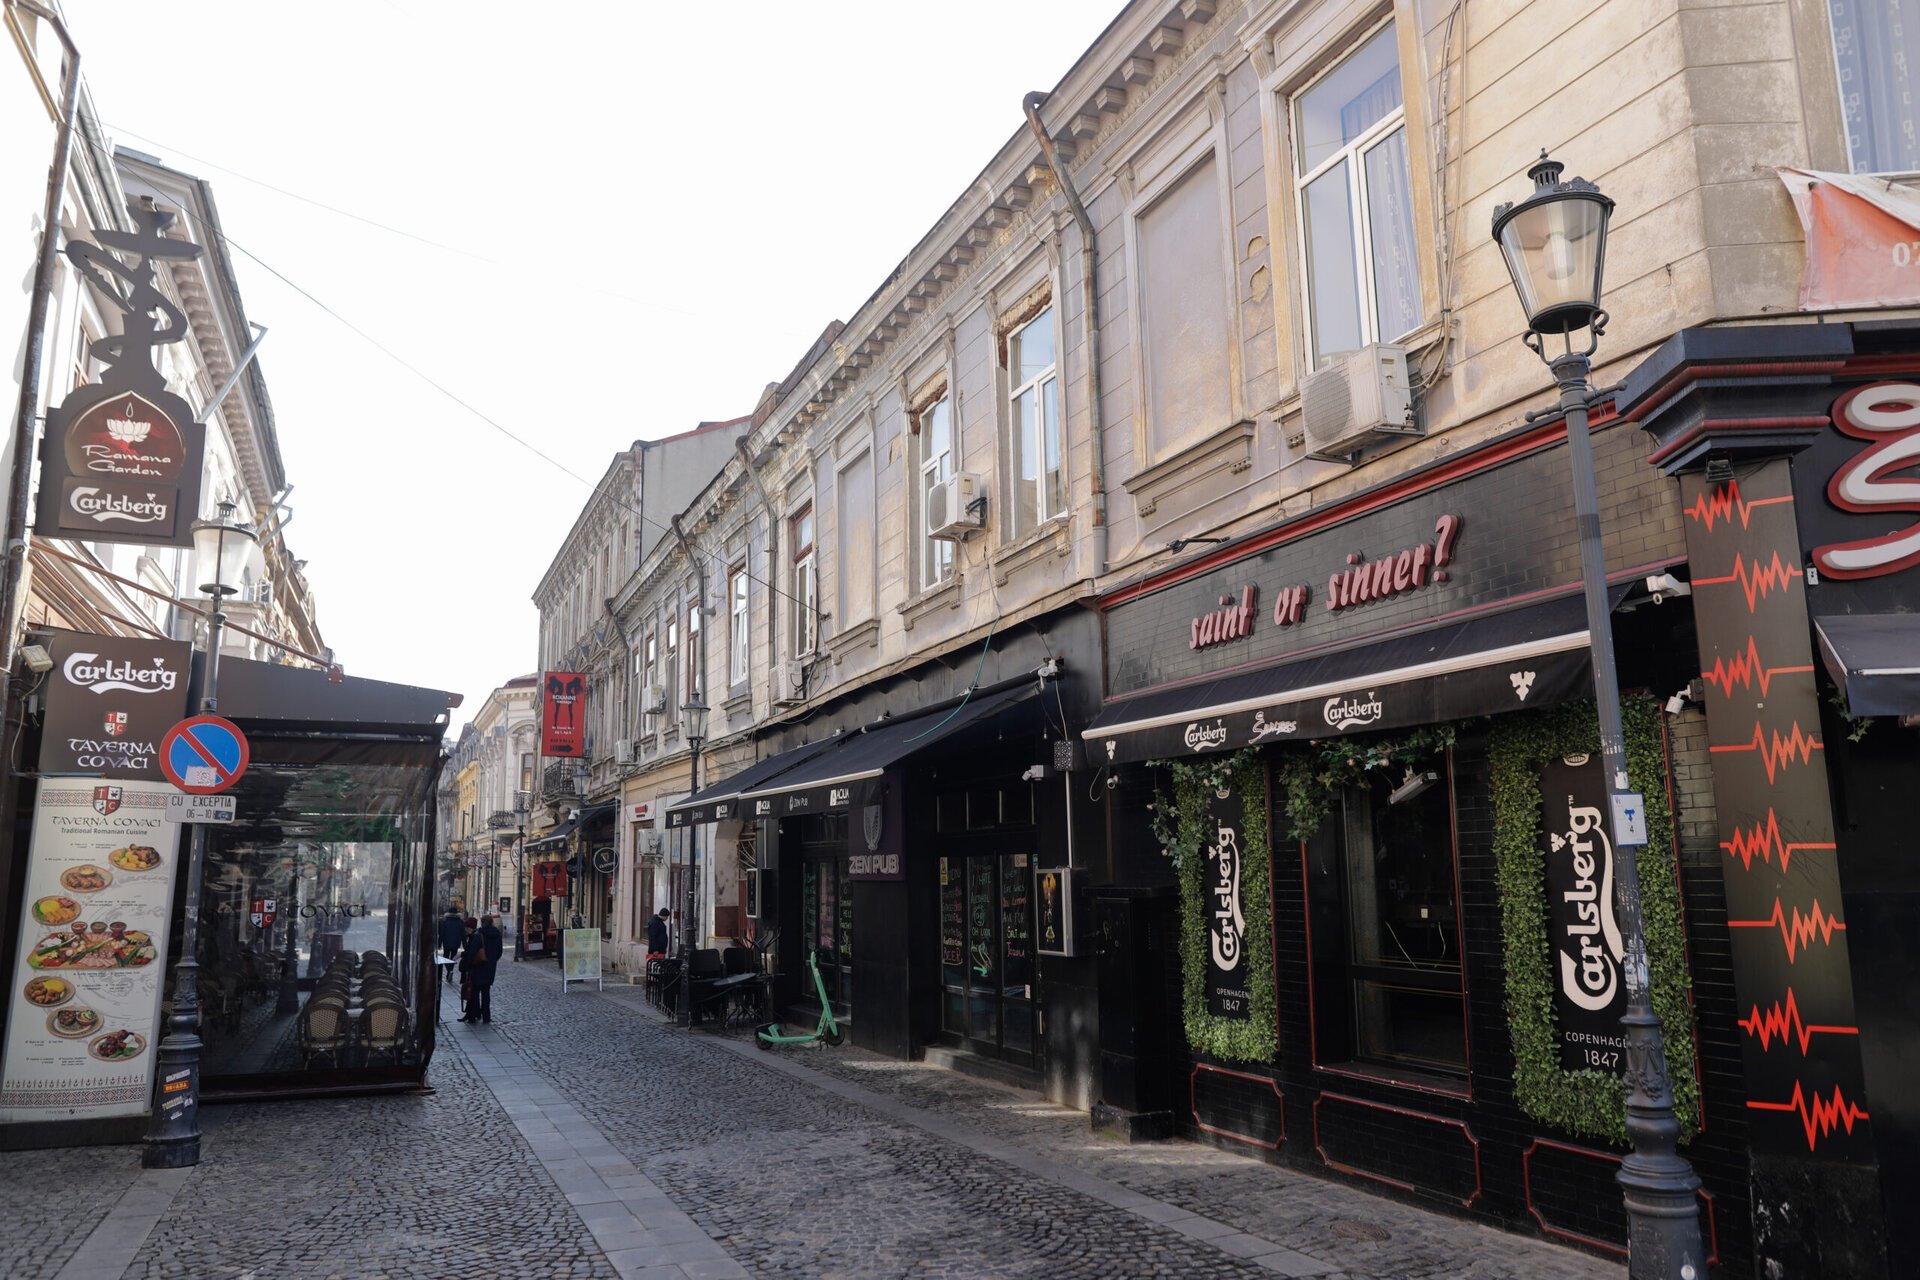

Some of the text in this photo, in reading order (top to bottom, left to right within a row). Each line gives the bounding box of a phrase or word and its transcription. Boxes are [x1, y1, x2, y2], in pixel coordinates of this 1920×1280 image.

[81, 445, 172, 463] Ramana
[88, 459, 163, 476] Garden
[70, 486, 167, 522] Carlsberg
[1189, 514, 1460, 651] saint or sinner?
[64, 652, 177, 694] Carlsberg
[1324, 693, 1382, 730] Carlsberg
[1185, 720, 1227, 752] Carlsberg
[67, 738, 156, 756] TAVERNA
[77, 755, 148, 769] COVACI
[172, 796, 232, 808] CU EXCEPTIA
[51, 815, 161, 827] TAVERNA COVACI
[186, 809, 195, 818] 06
[61, 827, 92, 835] Traditional
[849, 854, 899, 875] ZEN PUB
[1210, 827, 1245, 971] Carlsberg
[1556, 806, 1623, 1011] Carlsberg
[1222, 998, 1240, 1011] 1847
[1565, 1031, 1628, 1048] COPENHAGE
[1584, 1049, 1619, 1068] 1847
